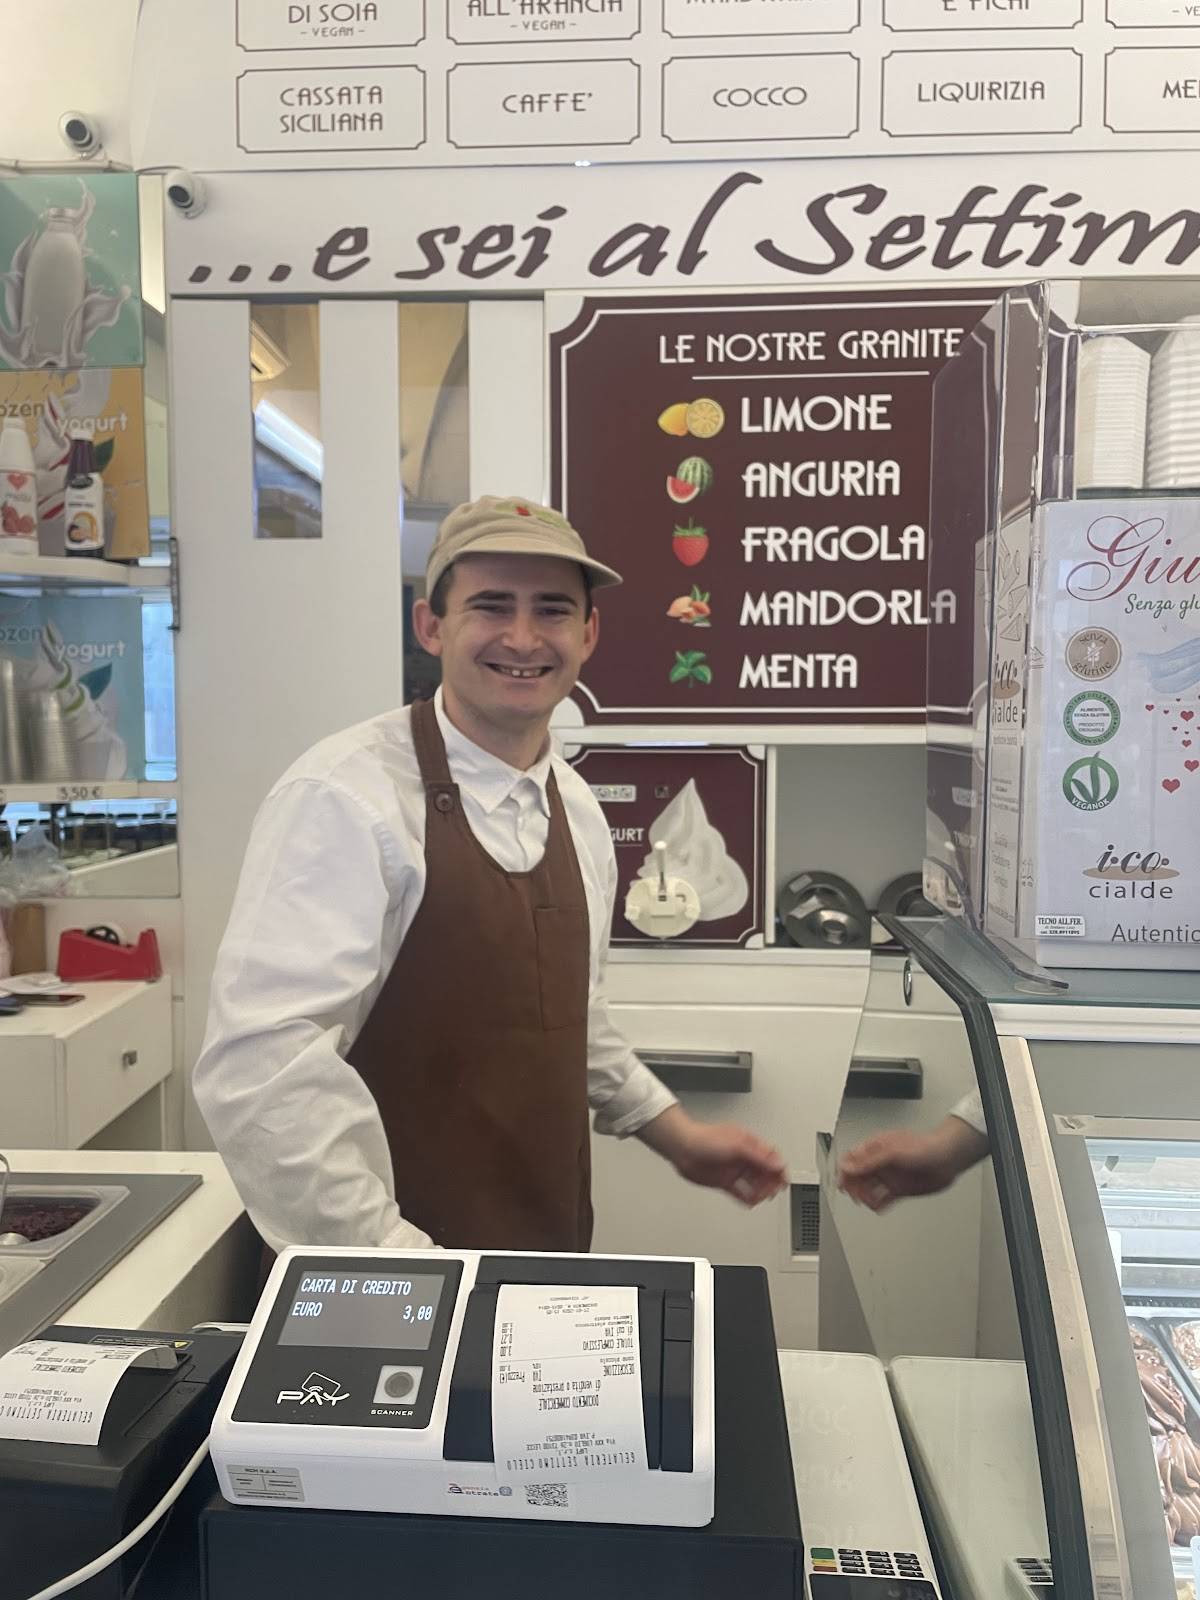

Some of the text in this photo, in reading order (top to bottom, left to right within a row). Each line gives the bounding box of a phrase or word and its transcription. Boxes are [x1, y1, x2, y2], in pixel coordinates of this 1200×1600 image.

[288, 2, 378, 24] DI SOIA
[311, 26, 355, 38] VEGAN
[521, 19, 566, 32] VEGAN
[280, 85, 383, 108] CASSATA
[713, 86, 807, 108] COCCO
[917, 81, 1045, 104] LIQUIRIZIA
[1162, 79, 1200, 98] ME
[502, 92, 593, 115] CAFFE'
[280, 111, 384, 134] SICILIANA
[395, 205, 568, 280] sei
[588, 171, 763, 277] al
[659, 328, 965, 364] LE NOSTRE GRANITE
[57, 412, 128, 437] yogurt
[740, 394, 893, 434] LIMONE
[741, 460, 901, 499] ANGURIA
[741, 524, 926, 563] FRAGOLA
[739, 589, 957, 627] MANDORLA
[1124, 593, 1175, 619] Senza
[1079, 631, 1109, 645] senza
[56, 640, 126, 663] yogurt
[738, 654, 858, 689] MENTA
[1072, 661, 1113, 678] glutine
[1071, 797, 1111, 811] VEGANOK
[1088, 881, 1174, 899] cialde
[1038, 917, 1057, 925] TECNO
[301, 1278, 412, 1296] CARTA DI CREDITO
[292, 1301, 433, 1323] EURO 3,00
[582, 1339, 614, 1351] COMPLESSIVO
[616, 1337, 634, 1350] TOTALE
[603, 1363, 635, 1377] DESCRIZIONE
[532, 1382, 564, 1394] prestazione
[571, 1380, 592, 1392] vendita
[276, 1389, 350, 1406] PAY
[538, 1394, 599, 1411] DOCUMENTO COMMERCIALE
[506, 1451, 635, 1471] GELATERIA SETTIMO CIELO
